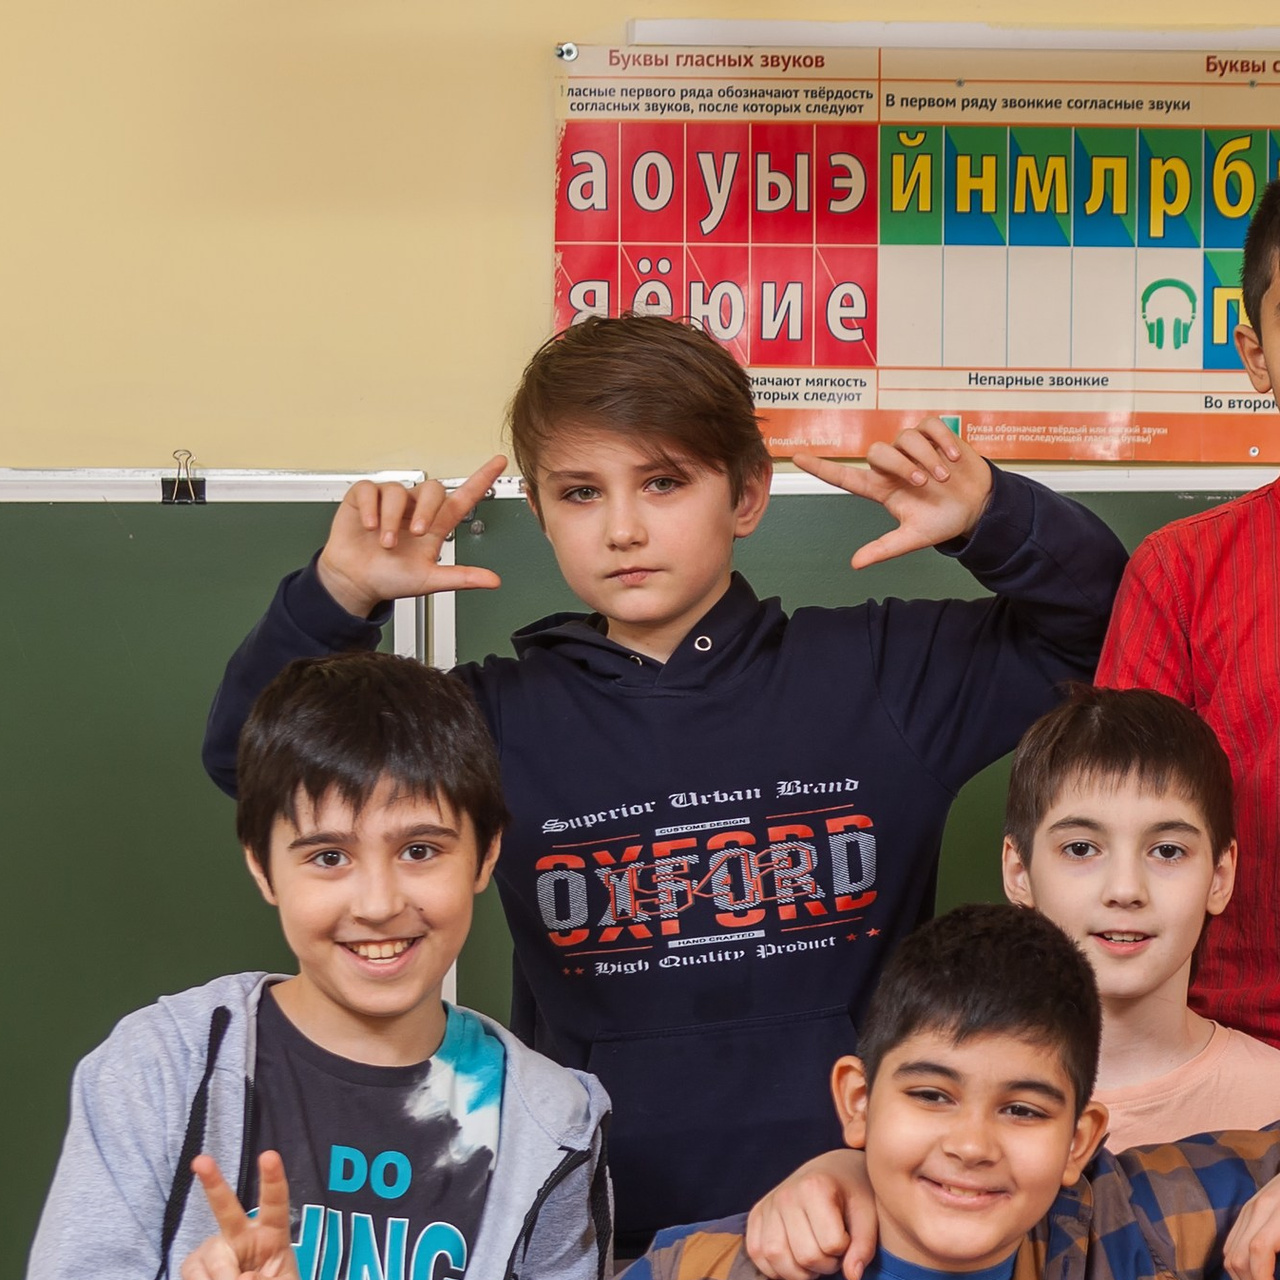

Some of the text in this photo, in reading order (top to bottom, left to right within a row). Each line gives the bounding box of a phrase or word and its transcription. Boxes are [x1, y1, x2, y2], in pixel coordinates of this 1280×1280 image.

[609, 49, 826, 72] Буквы гласных звуков
[1205, 55, 1267, 78] Буквы
[561, 86, 874, 101] ласные первого ряда обозначают твёрдость
[570, 102, 865, 117] согласных звуков, после которых следуют
[885, 93, 1191, 113] В первом ряду звонкие согласные звуки
[567, 149, 867, 237] а о у ы э
[890, 131, 1256, 239] й н м л р б
[760, 281, 804, 341] и
[826, 281, 867, 342] е
[805, 376, 867, 388] мягкость
[967, 372, 1110, 388] Непарные звонкие
[803, 391, 862, 404] следуют
[1204, 395, 1223, 409] Во
[966, 423, 993, 434] Буква
[995, 424, 1048, 434] обозначает
[1006, 434, 1017, 442] от
[1018, 433, 1083, 444] последующей
[541, 778, 860, 834] Superior Urban Brand
[659, 818, 746, 834] CUSTOME DESIGN
[535, 814, 878, 947] OXFORD
[677, 931, 756, 947] HAND CRAFTED
[593, 935, 837, 976] High Quality Product
[328, 1144, 413, 1200] DO
